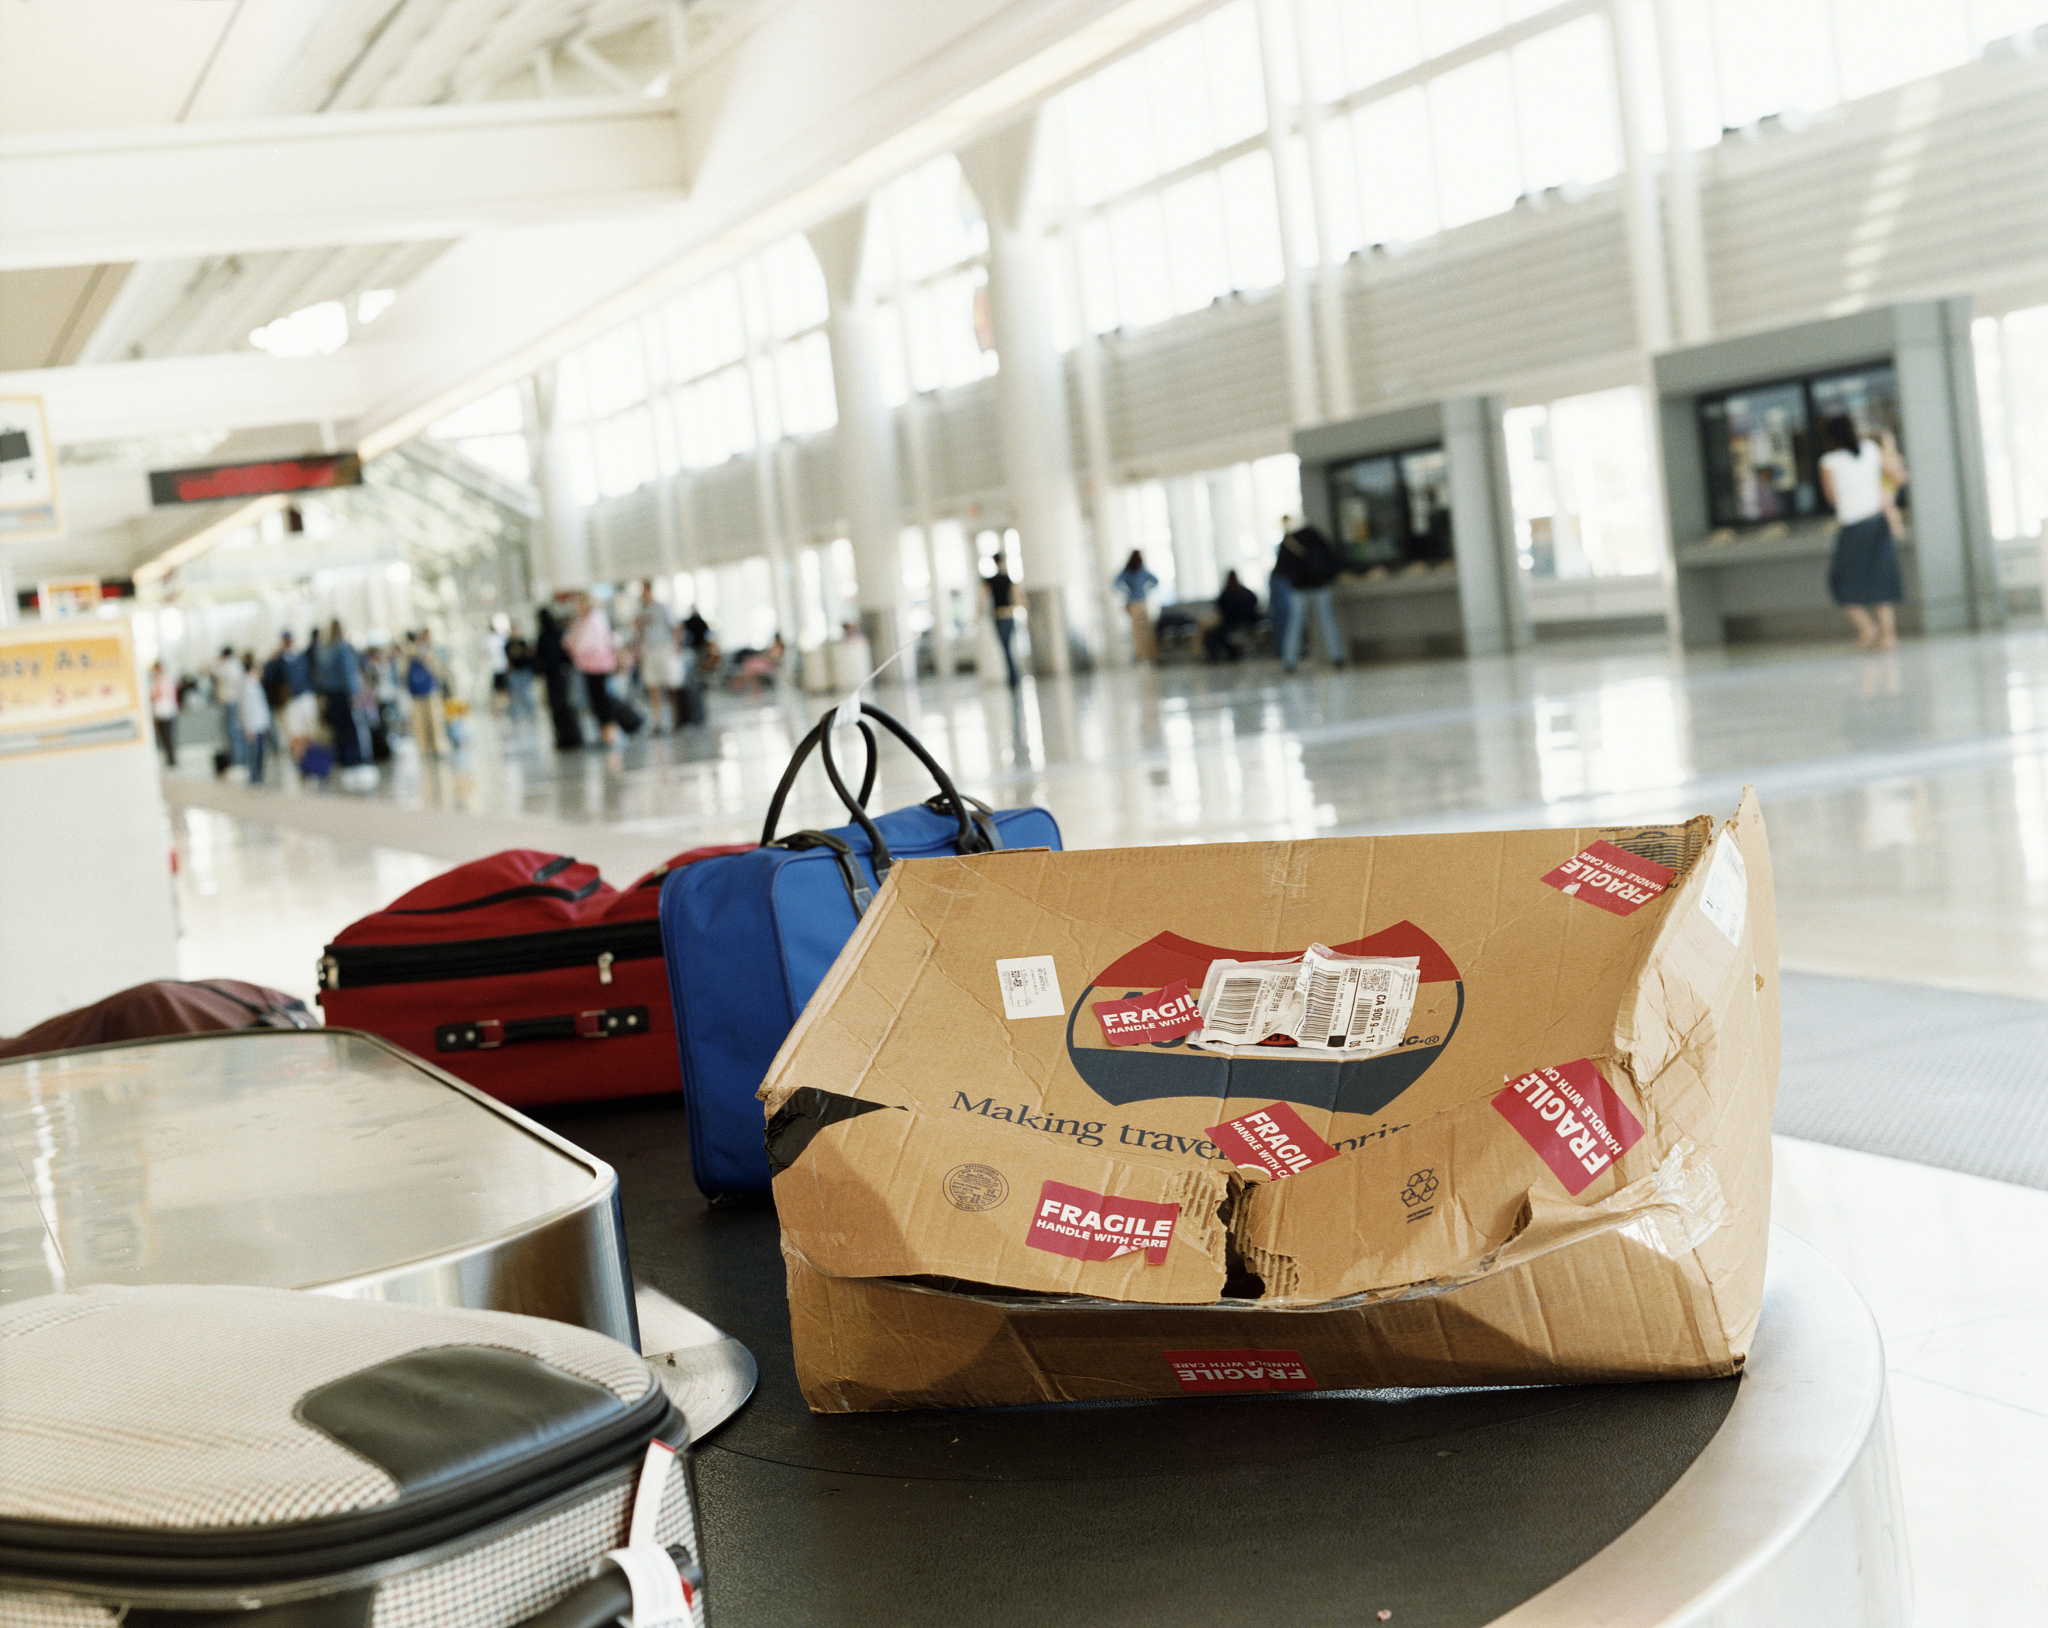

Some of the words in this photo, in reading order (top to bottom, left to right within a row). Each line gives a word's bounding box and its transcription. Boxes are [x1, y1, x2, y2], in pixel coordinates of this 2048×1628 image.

[1578, 851, 1604, 866] CARE
[1602, 861, 1628, 877] WITH
[1560, 858, 1654, 905] FRAGILE
[1625, 872, 1664, 892] HANDLE
[1375, 994, 1387, 1006] CA
[1107, 1022, 1156, 1034] HANDLE
[1158, 1014, 1191, 1027] WITH
[1371, 1007, 1384, 1021] 900
[1556, 1079, 1585, 1108] WITH
[950, 1090, 1107, 1147] Making
[1513, 1073, 1610, 1175] FRAGILE
[1581, 1105, 1623, 1155] HANDLE
[1230, 1121, 1263, 1151] HANDLE
[1258, 1149, 1282, 1170] WITH
[1040, 1199, 1172, 1237] FRAGILE
[1036, 1219, 1090, 1240] HANDLE
[1094, 1233, 1129, 1245] WITH
[1132, 1238, 1168, 1248] CARE
[1177, 1367, 1307, 1381] FRAGILE
[1248, 1360, 1300, 1368] HANDLE
